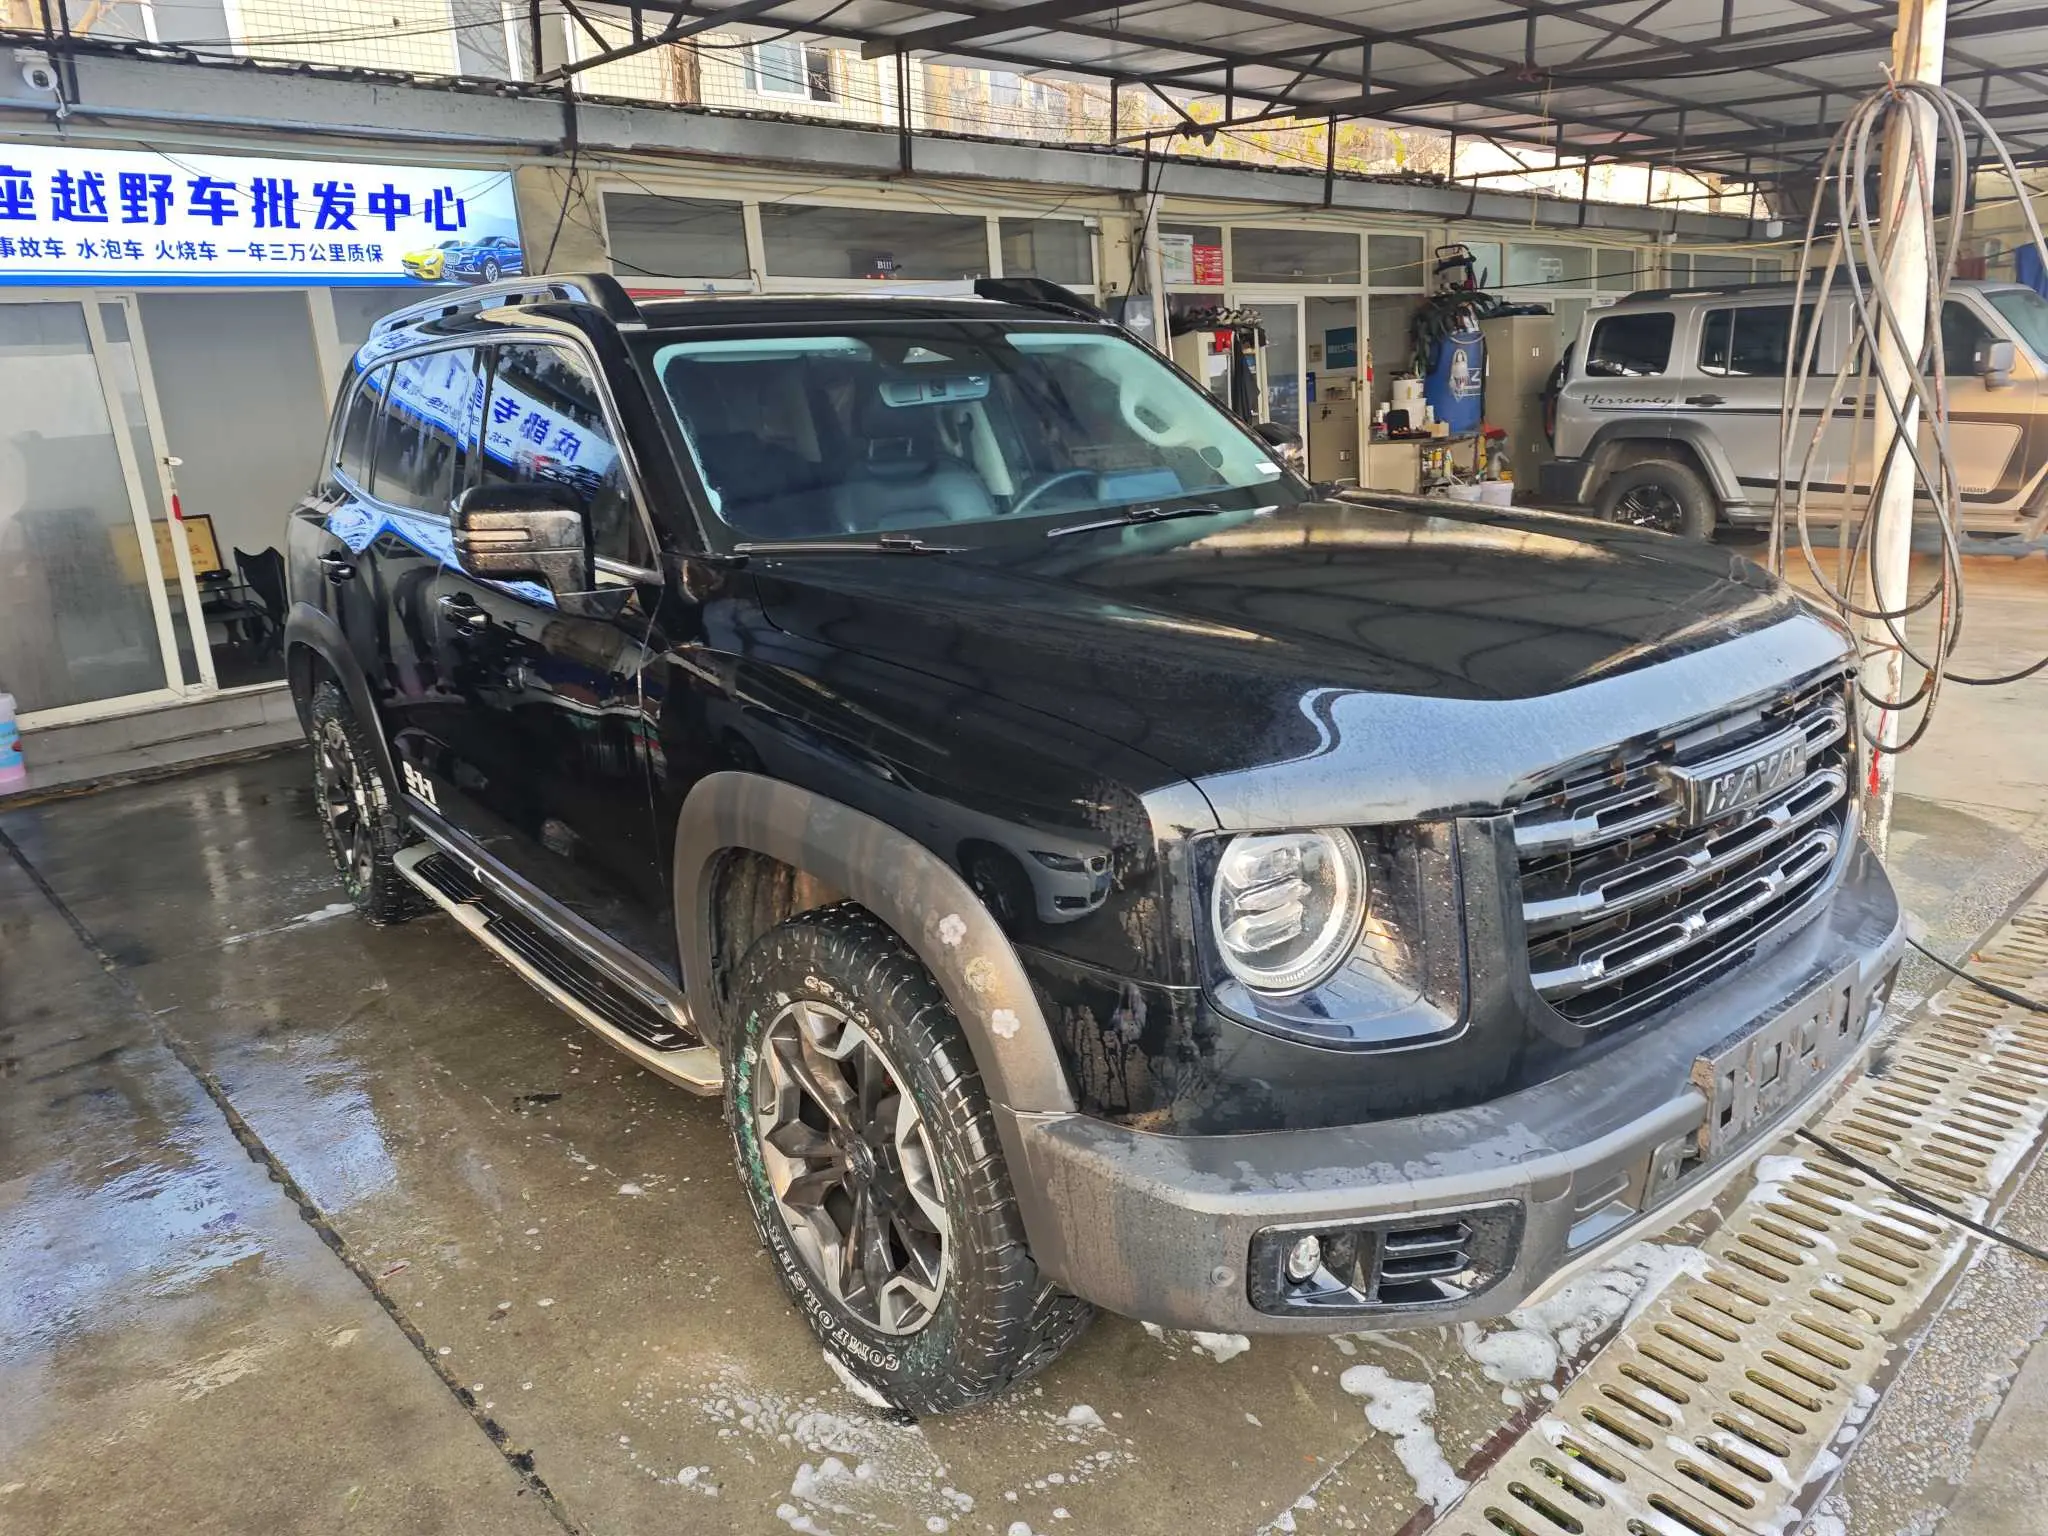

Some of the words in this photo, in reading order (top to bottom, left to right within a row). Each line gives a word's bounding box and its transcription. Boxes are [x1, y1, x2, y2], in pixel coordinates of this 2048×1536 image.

[0, 165, 467, 231] 座越野车批发中心
[0, 237, 66, 259] 事故车
[77, 238, 145, 260] 水泡车
[156, 240, 219, 261] 火烧车
[227, 242, 384, 263] 一年三万公里质保
[769, 1225, 900, 1372] COMFORSER
